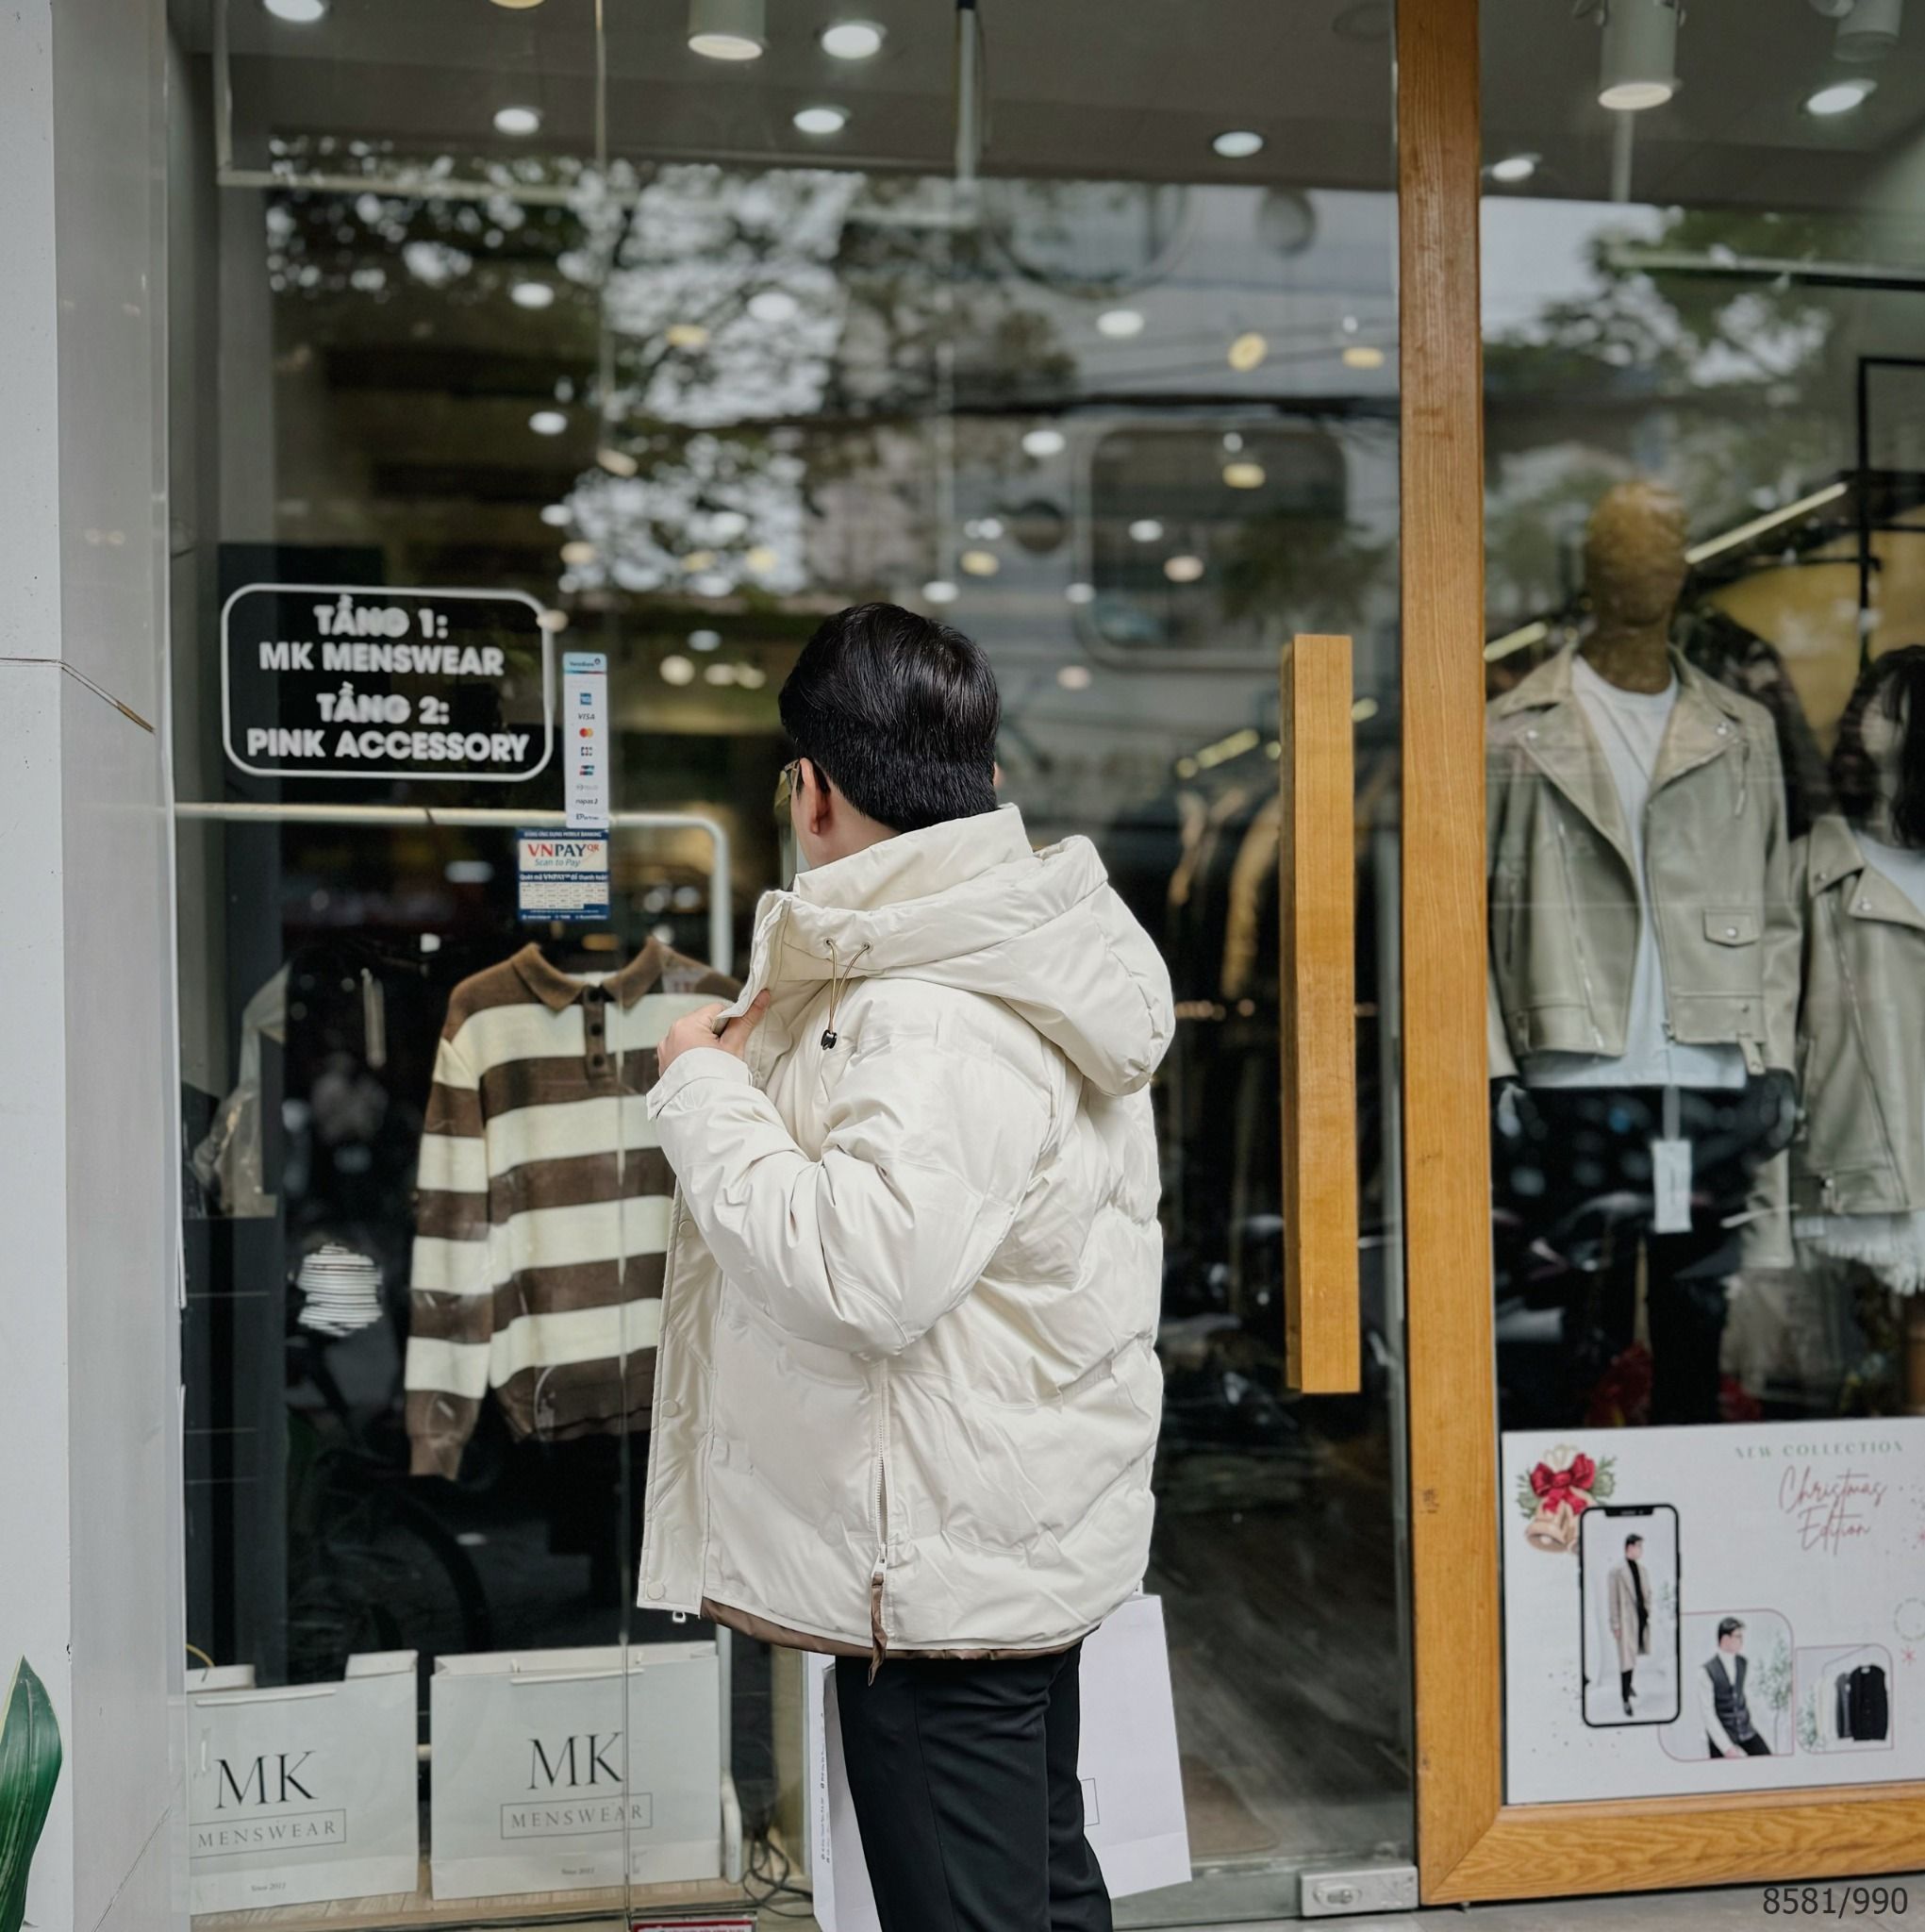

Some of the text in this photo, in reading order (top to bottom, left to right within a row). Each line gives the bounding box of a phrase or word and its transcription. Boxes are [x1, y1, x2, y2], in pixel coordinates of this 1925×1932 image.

[418, 608, 449, 639] 1:
[259, 641, 505, 675] MK MENSWEAR
[419, 695, 450, 724] 2:
[247, 728, 530, 761] PINK ACCESSORY
[556, 858, 564, 866] to
[566, 858, 581, 868] Pay
[1735, 1441, 1903, 1458] NEW COLLECTION
[1779, 1464, 1887, 1515] Christmas
[527, 1731, 624, 1790] MK
[213, 1750, 320, 1809] MK
[512, 1805, 642, 1828] MENSWEAR
[198, 1820, 336, 1848] MENSWEAR
